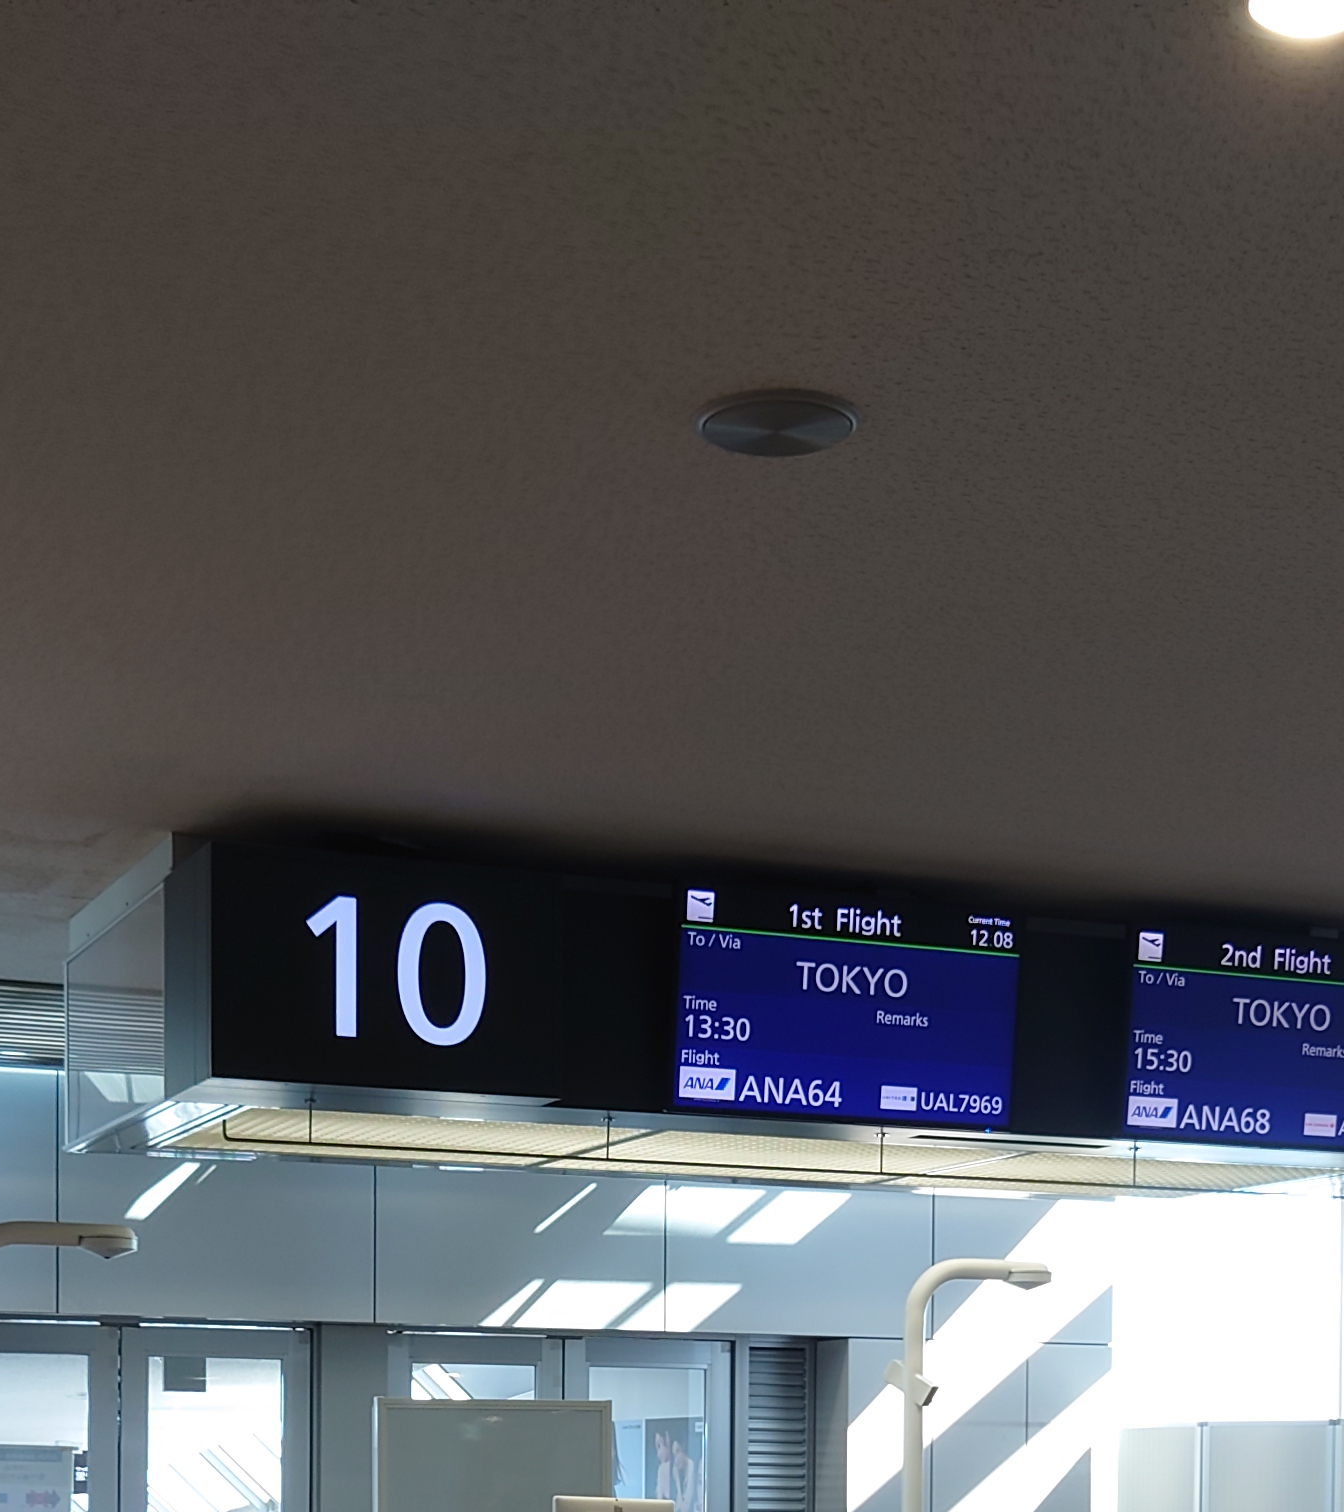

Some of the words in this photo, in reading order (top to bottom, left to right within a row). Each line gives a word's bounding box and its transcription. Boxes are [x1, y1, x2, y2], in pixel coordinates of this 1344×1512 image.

[789, 903, 823, 930] 1st
[836, 907, 901, 938] Flight
[968, 915, 993, 925] Current
[994, 917, 1011, 927] Time
[687, 932, 707, 946] To
[718, 934, 741, 950] Via
[306, 895, 487, 1046] 10
[1220, 943, 1262, 970] 2nd
[1273, 947, 1332, 976] Flight
[796, 961, 908, 998] TOKYO
[1138, 970, 1155, 984] To
[1166, 972, 1185, 987] Via
[683, 995, 717, 1012] Time
[1232, 997, 1331, 1032] TOKYO
[684, 1013, 751, 1042] 13:30
[876, 1010, 928, 1028] Remarks
[1133, 1029, 1163, 1045] Time
[681, 1049, 720, 1066] Flight
[1133, 1047, 1192, 1073] 15:30
[683, 1076, 714, 1091] ANA
[739, 1075, 842, 1108] ANA64
[920, 1091, 1003, 1115] UAL7969
[1130, 1080, 1164, 1096] Flight
[1131, 1104, 1158, 1118] ANA
[1179, 1104, 1271, 1135] ANA68
